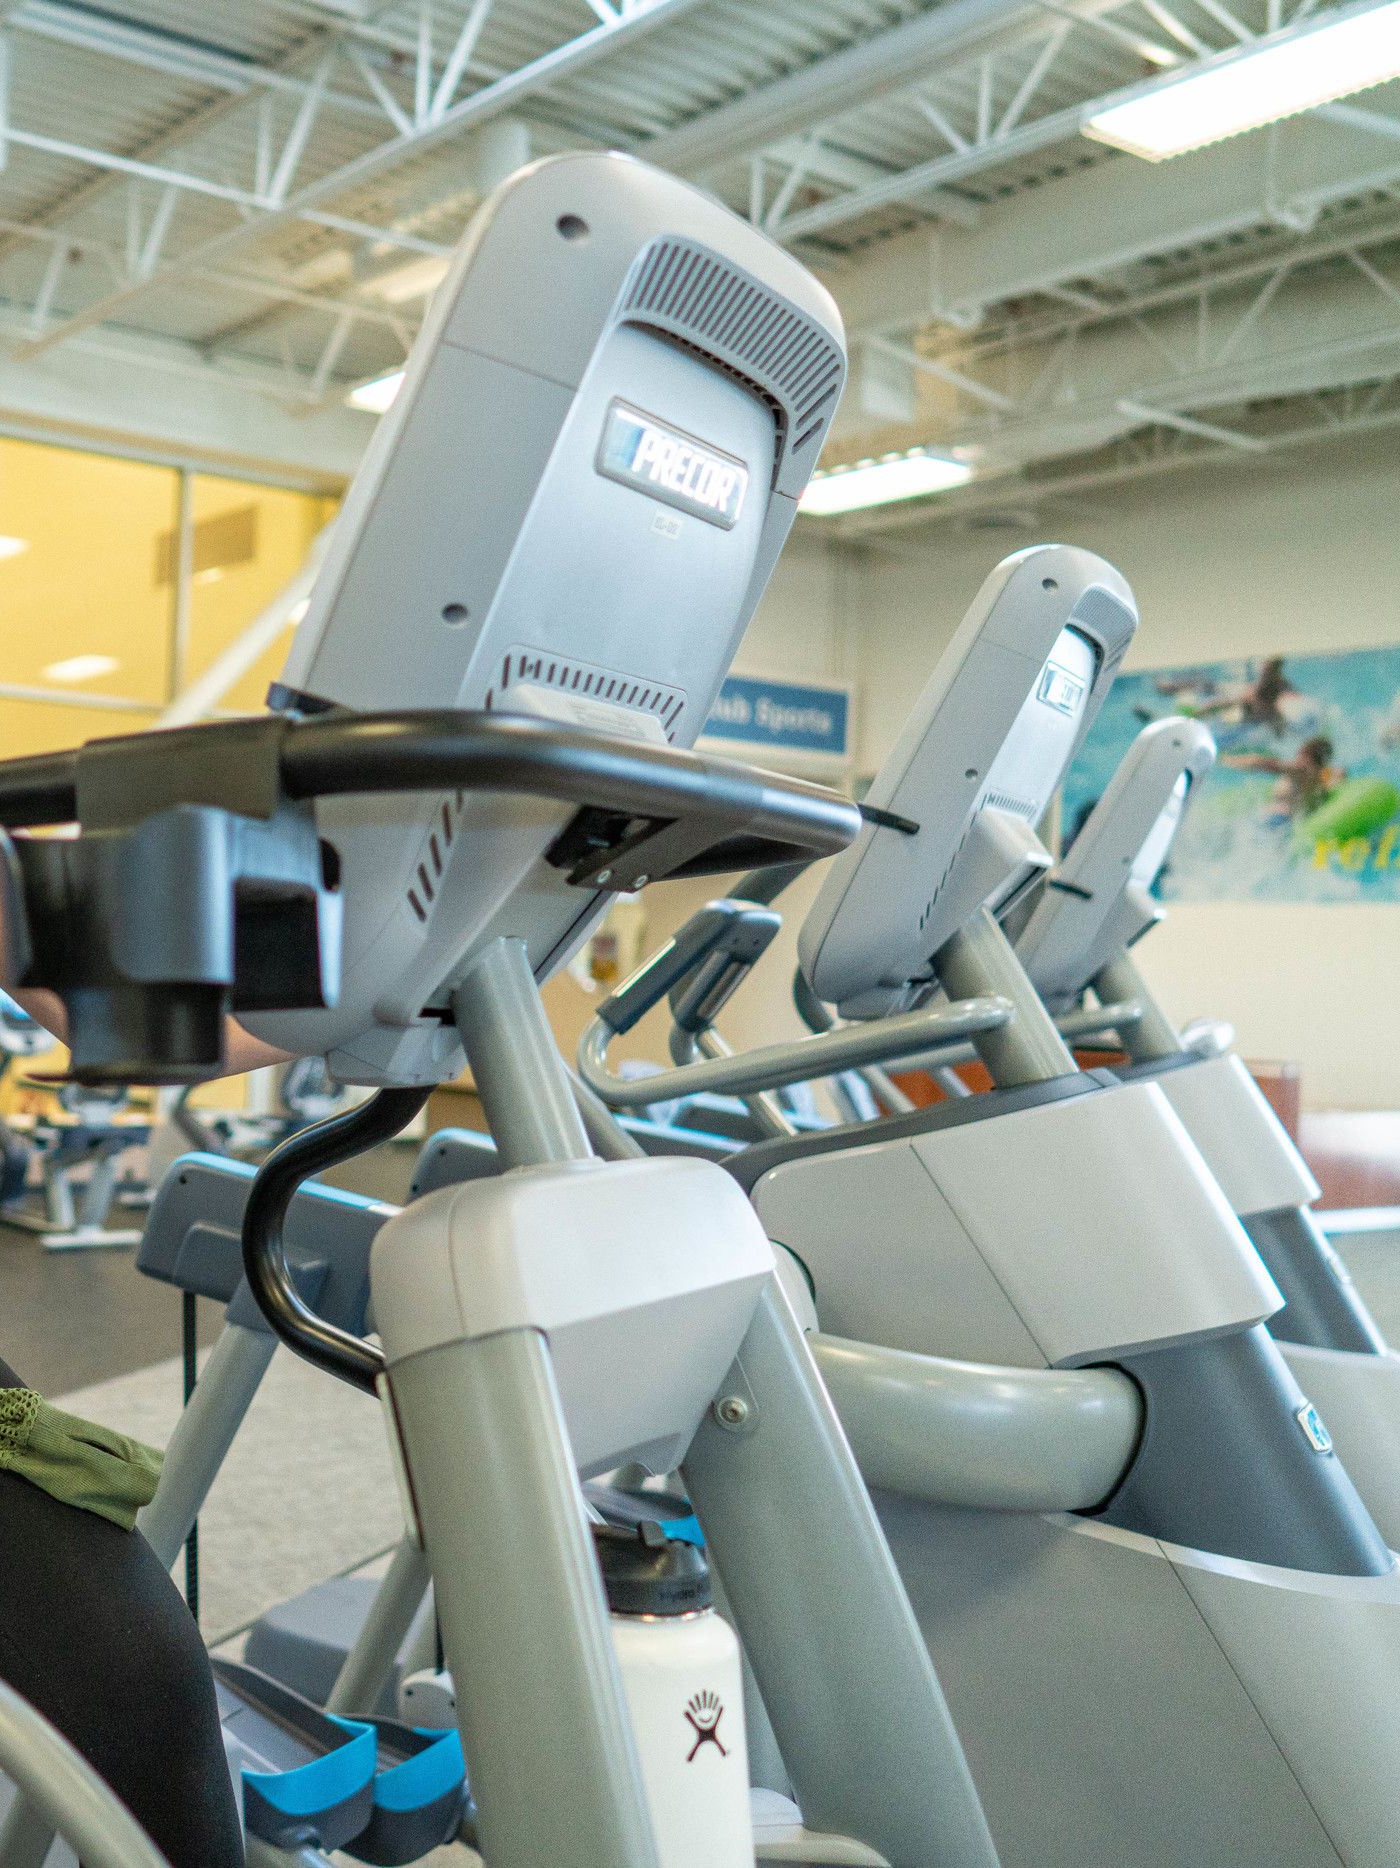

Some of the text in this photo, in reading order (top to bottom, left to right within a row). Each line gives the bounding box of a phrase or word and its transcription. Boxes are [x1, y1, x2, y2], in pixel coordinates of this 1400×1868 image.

[631, 428, 736, 512] PRECOR
[754, 698, 832, 736] Sports
[1312, 825, 1400, 869] rol
